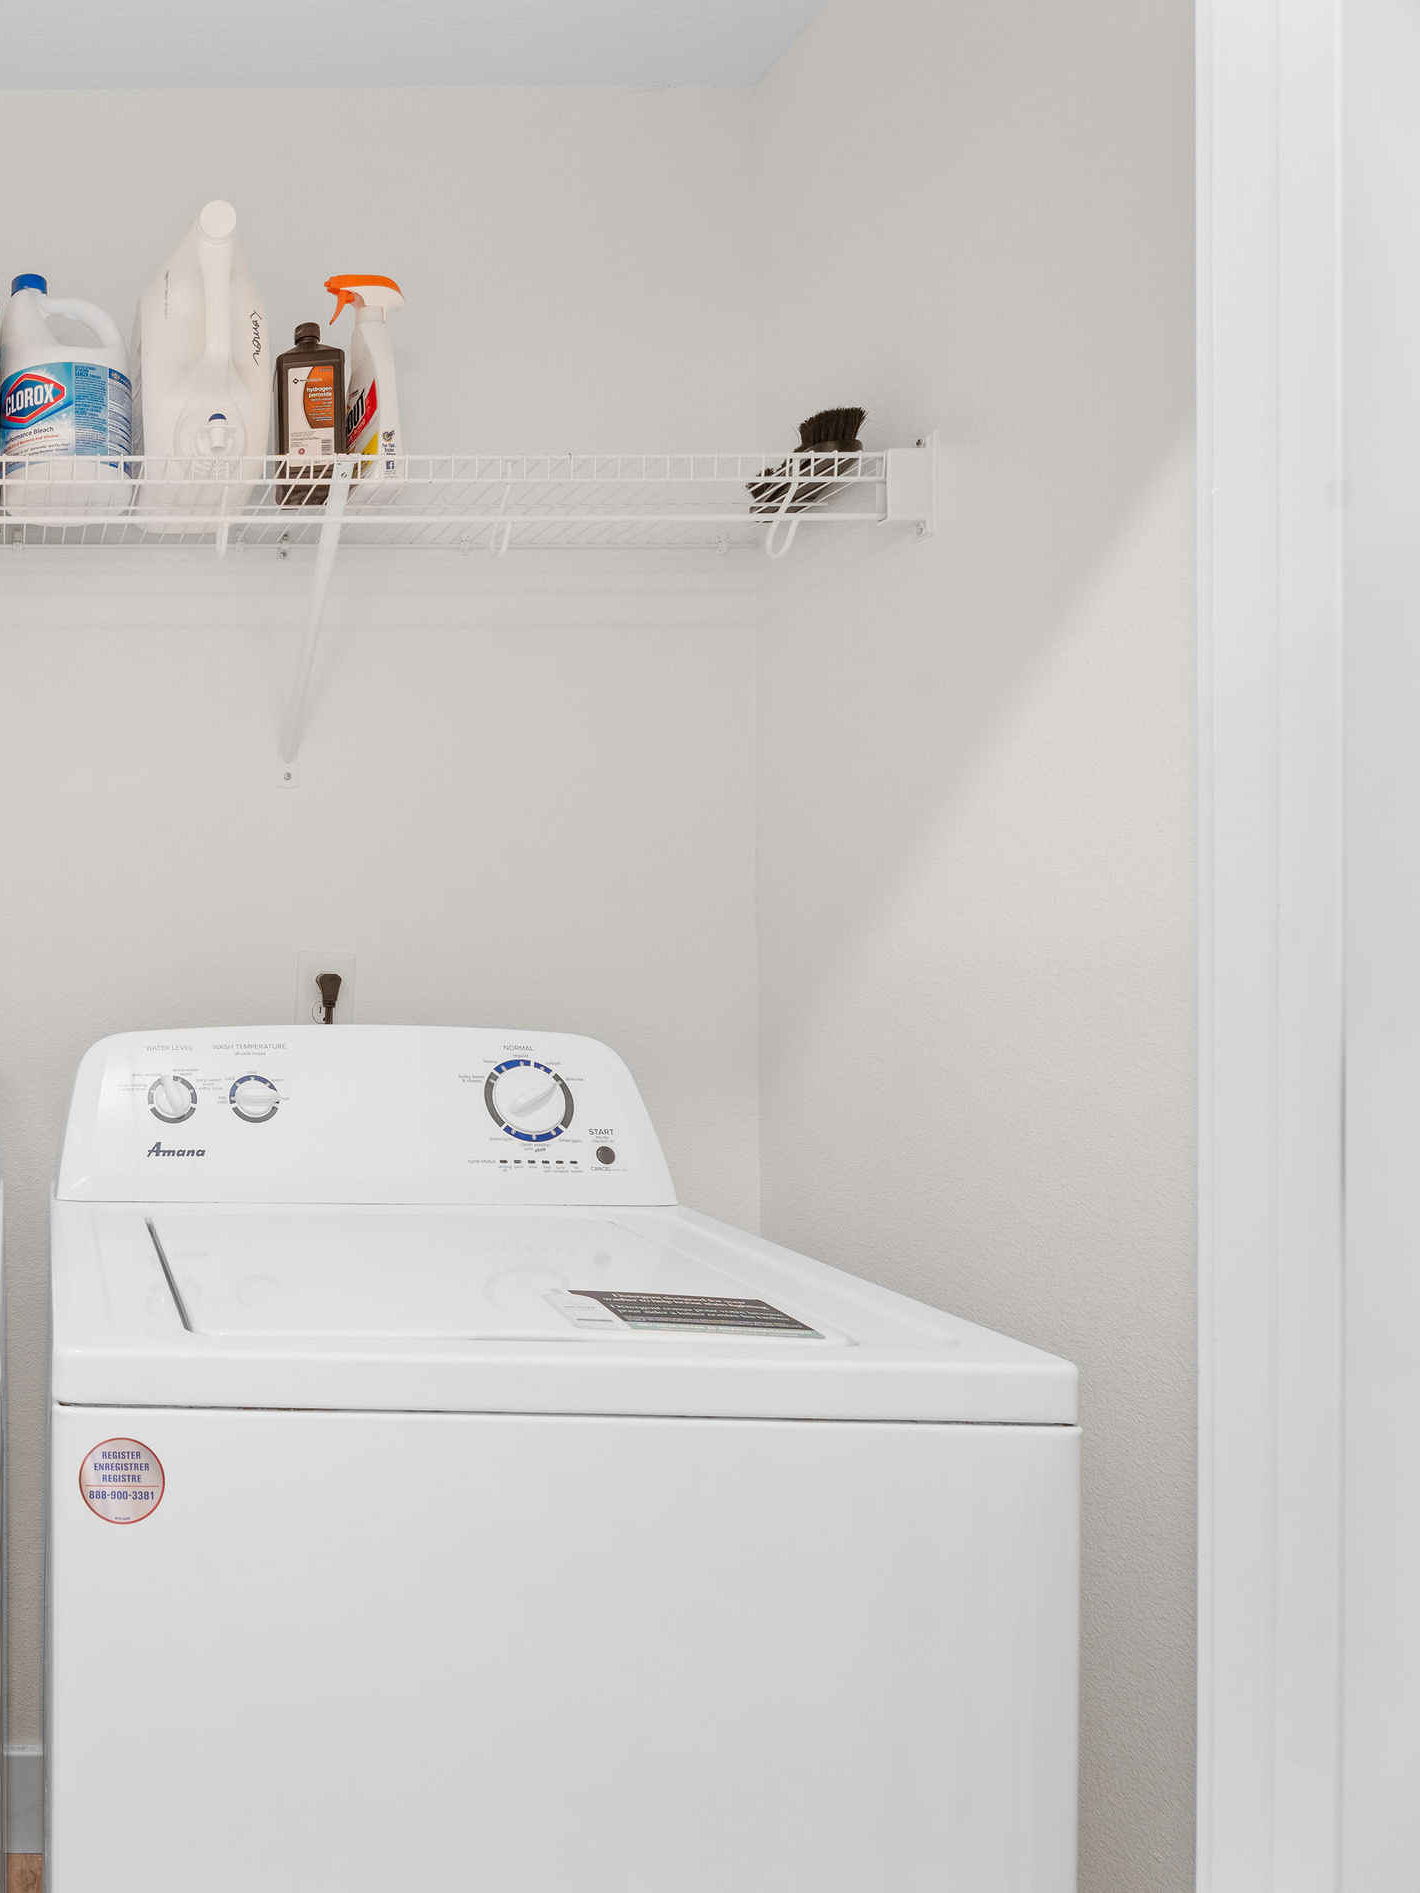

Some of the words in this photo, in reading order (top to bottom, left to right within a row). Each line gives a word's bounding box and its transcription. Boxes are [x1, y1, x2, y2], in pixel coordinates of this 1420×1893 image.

[5, 382, 55, 417] CLOROX
[588, 1128, 614, 1136] START
[146, 1141, 206, 1158] Amana
[101, 1451, 142, 1460] REGISTER
[93, 1462, 150, 1471] ENREGISTRER
[102, 1474, 142, 1483] REGISTRE
[89, 1490, 155, 1500] 888-900-3381
